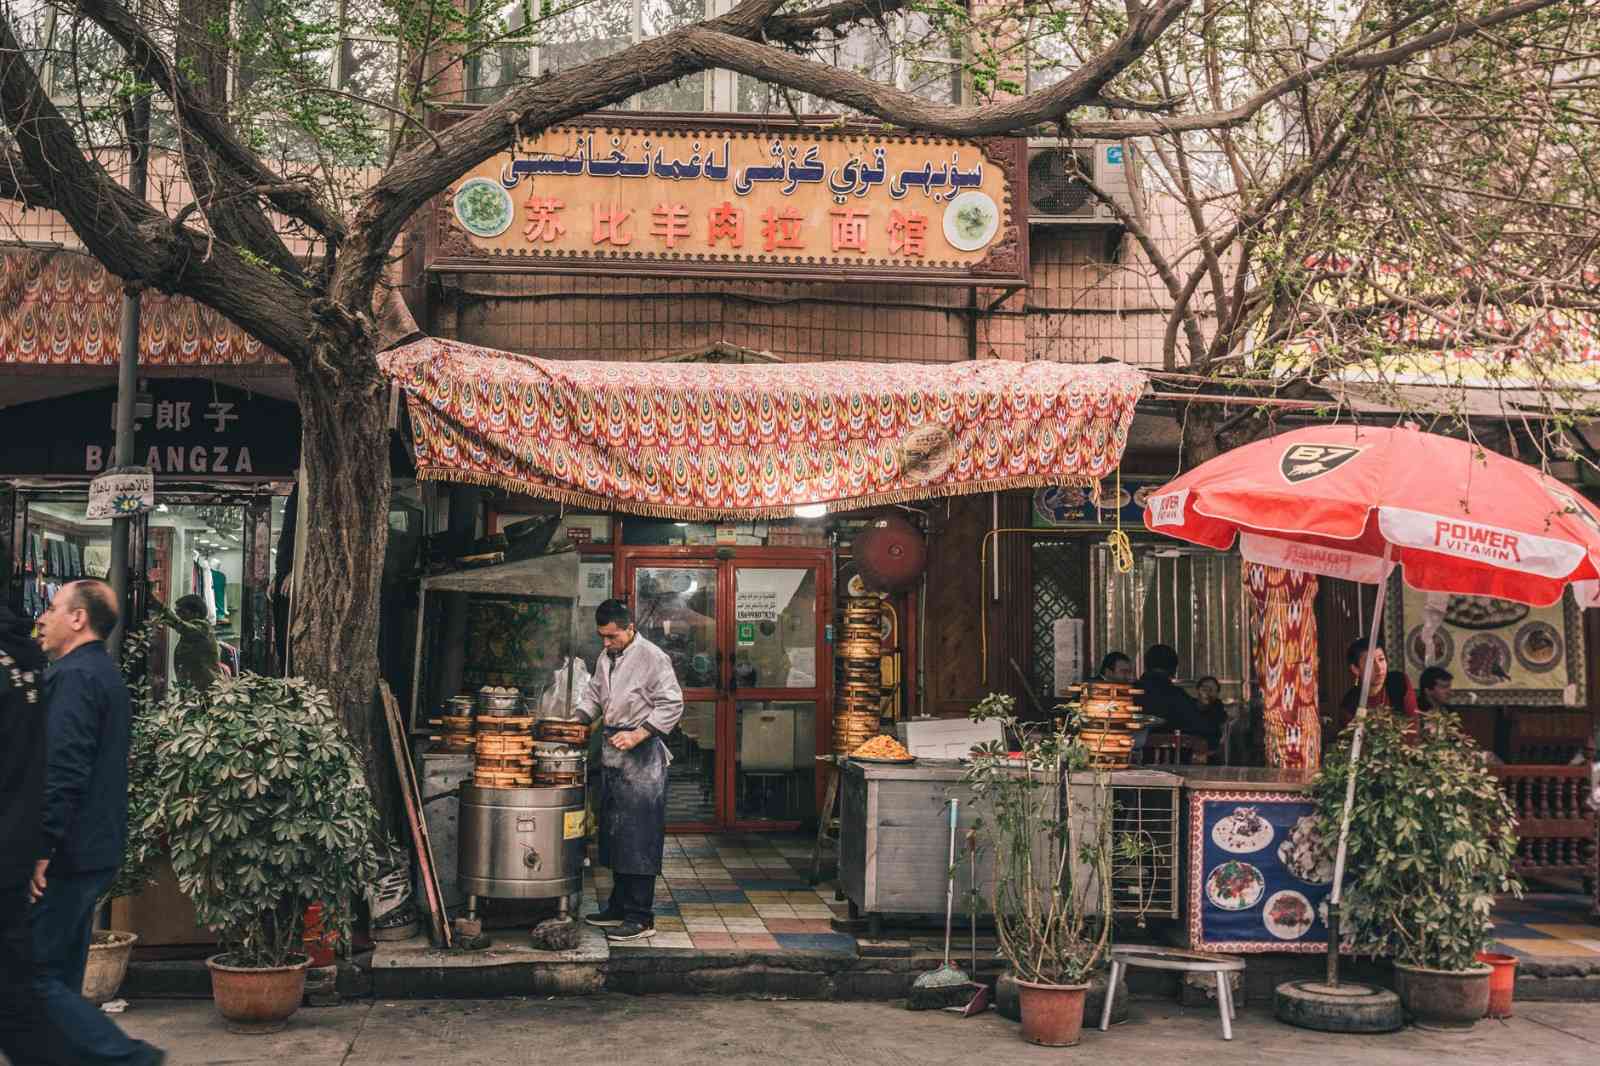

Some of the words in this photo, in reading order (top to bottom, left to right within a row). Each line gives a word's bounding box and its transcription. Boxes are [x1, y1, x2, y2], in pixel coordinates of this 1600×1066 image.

[523, 198, 929, 257] 苏比羊肉拉面馆
[111, 400, 239, 432] 郎子
[86, 444, 253, 473] BAANGZA
[1434, 520, 1521, 563] POWER
[1446, 539, 1511, 562] VITAMIN
